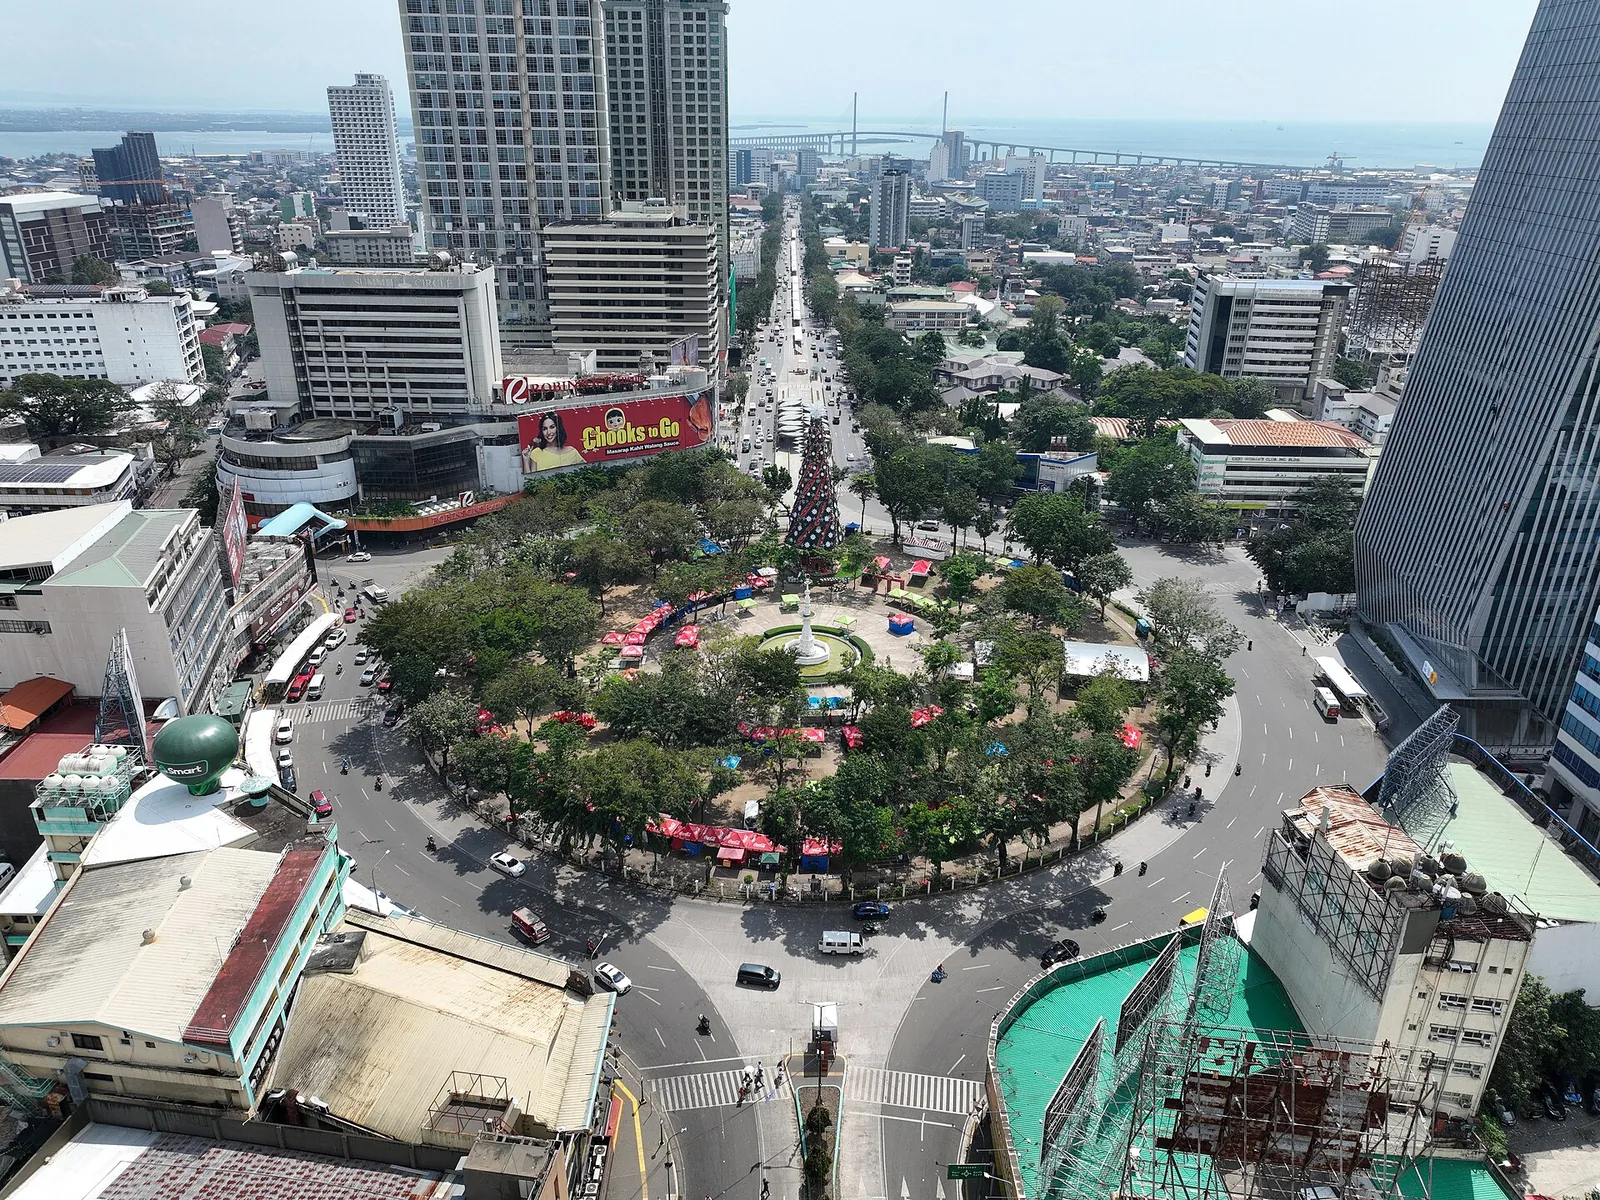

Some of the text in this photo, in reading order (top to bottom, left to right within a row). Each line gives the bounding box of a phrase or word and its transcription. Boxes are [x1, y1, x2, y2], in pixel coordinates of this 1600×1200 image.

[414, 279, 453, 288] CIRCLE
[582, 417, 680, 450] Chooks to Go
[606, 447, 630, 455] Masarap
[644, 442, 663, 450] Walang
[167, 765, 203, 775] Smart
